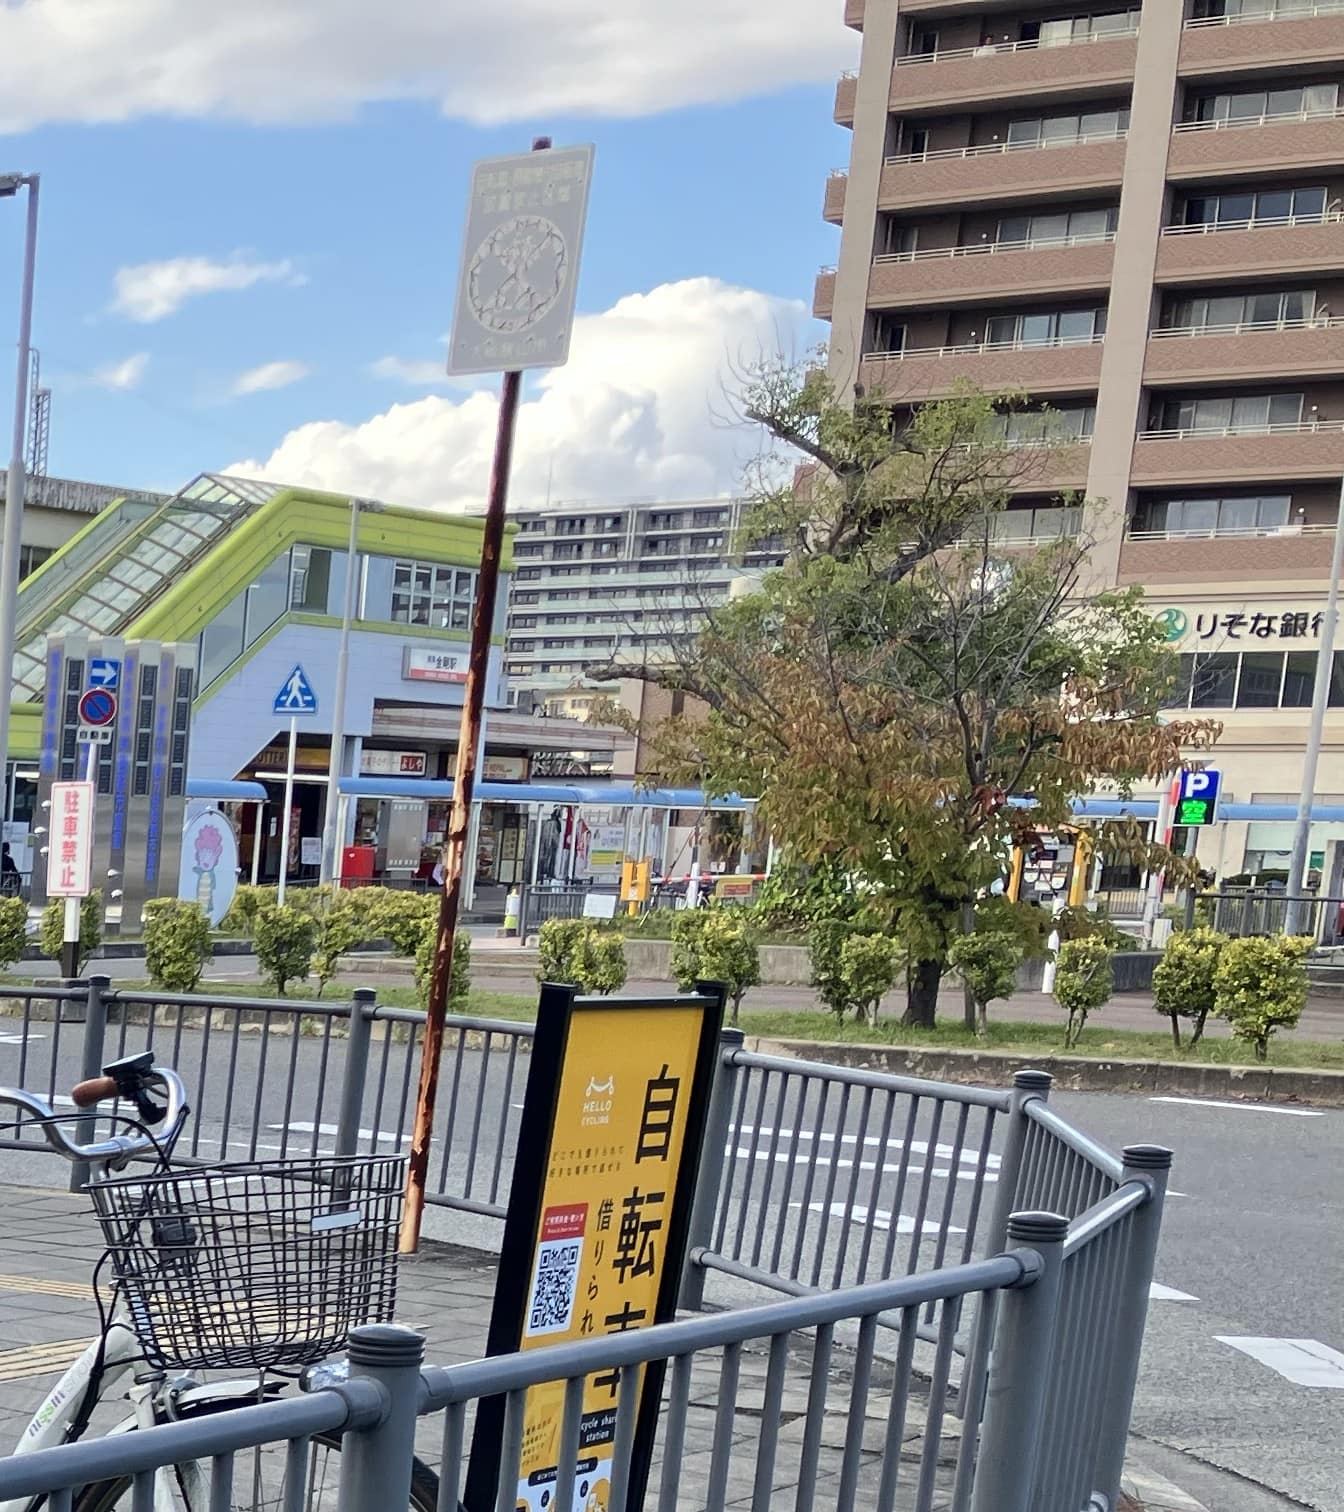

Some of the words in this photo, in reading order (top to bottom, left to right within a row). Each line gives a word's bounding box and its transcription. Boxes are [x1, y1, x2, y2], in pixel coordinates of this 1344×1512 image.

[1185, 773, 1209, 798] P
[60, 790, 80, 888] 駐車禁止
[583, 1099, 612, 1112] HELLO
